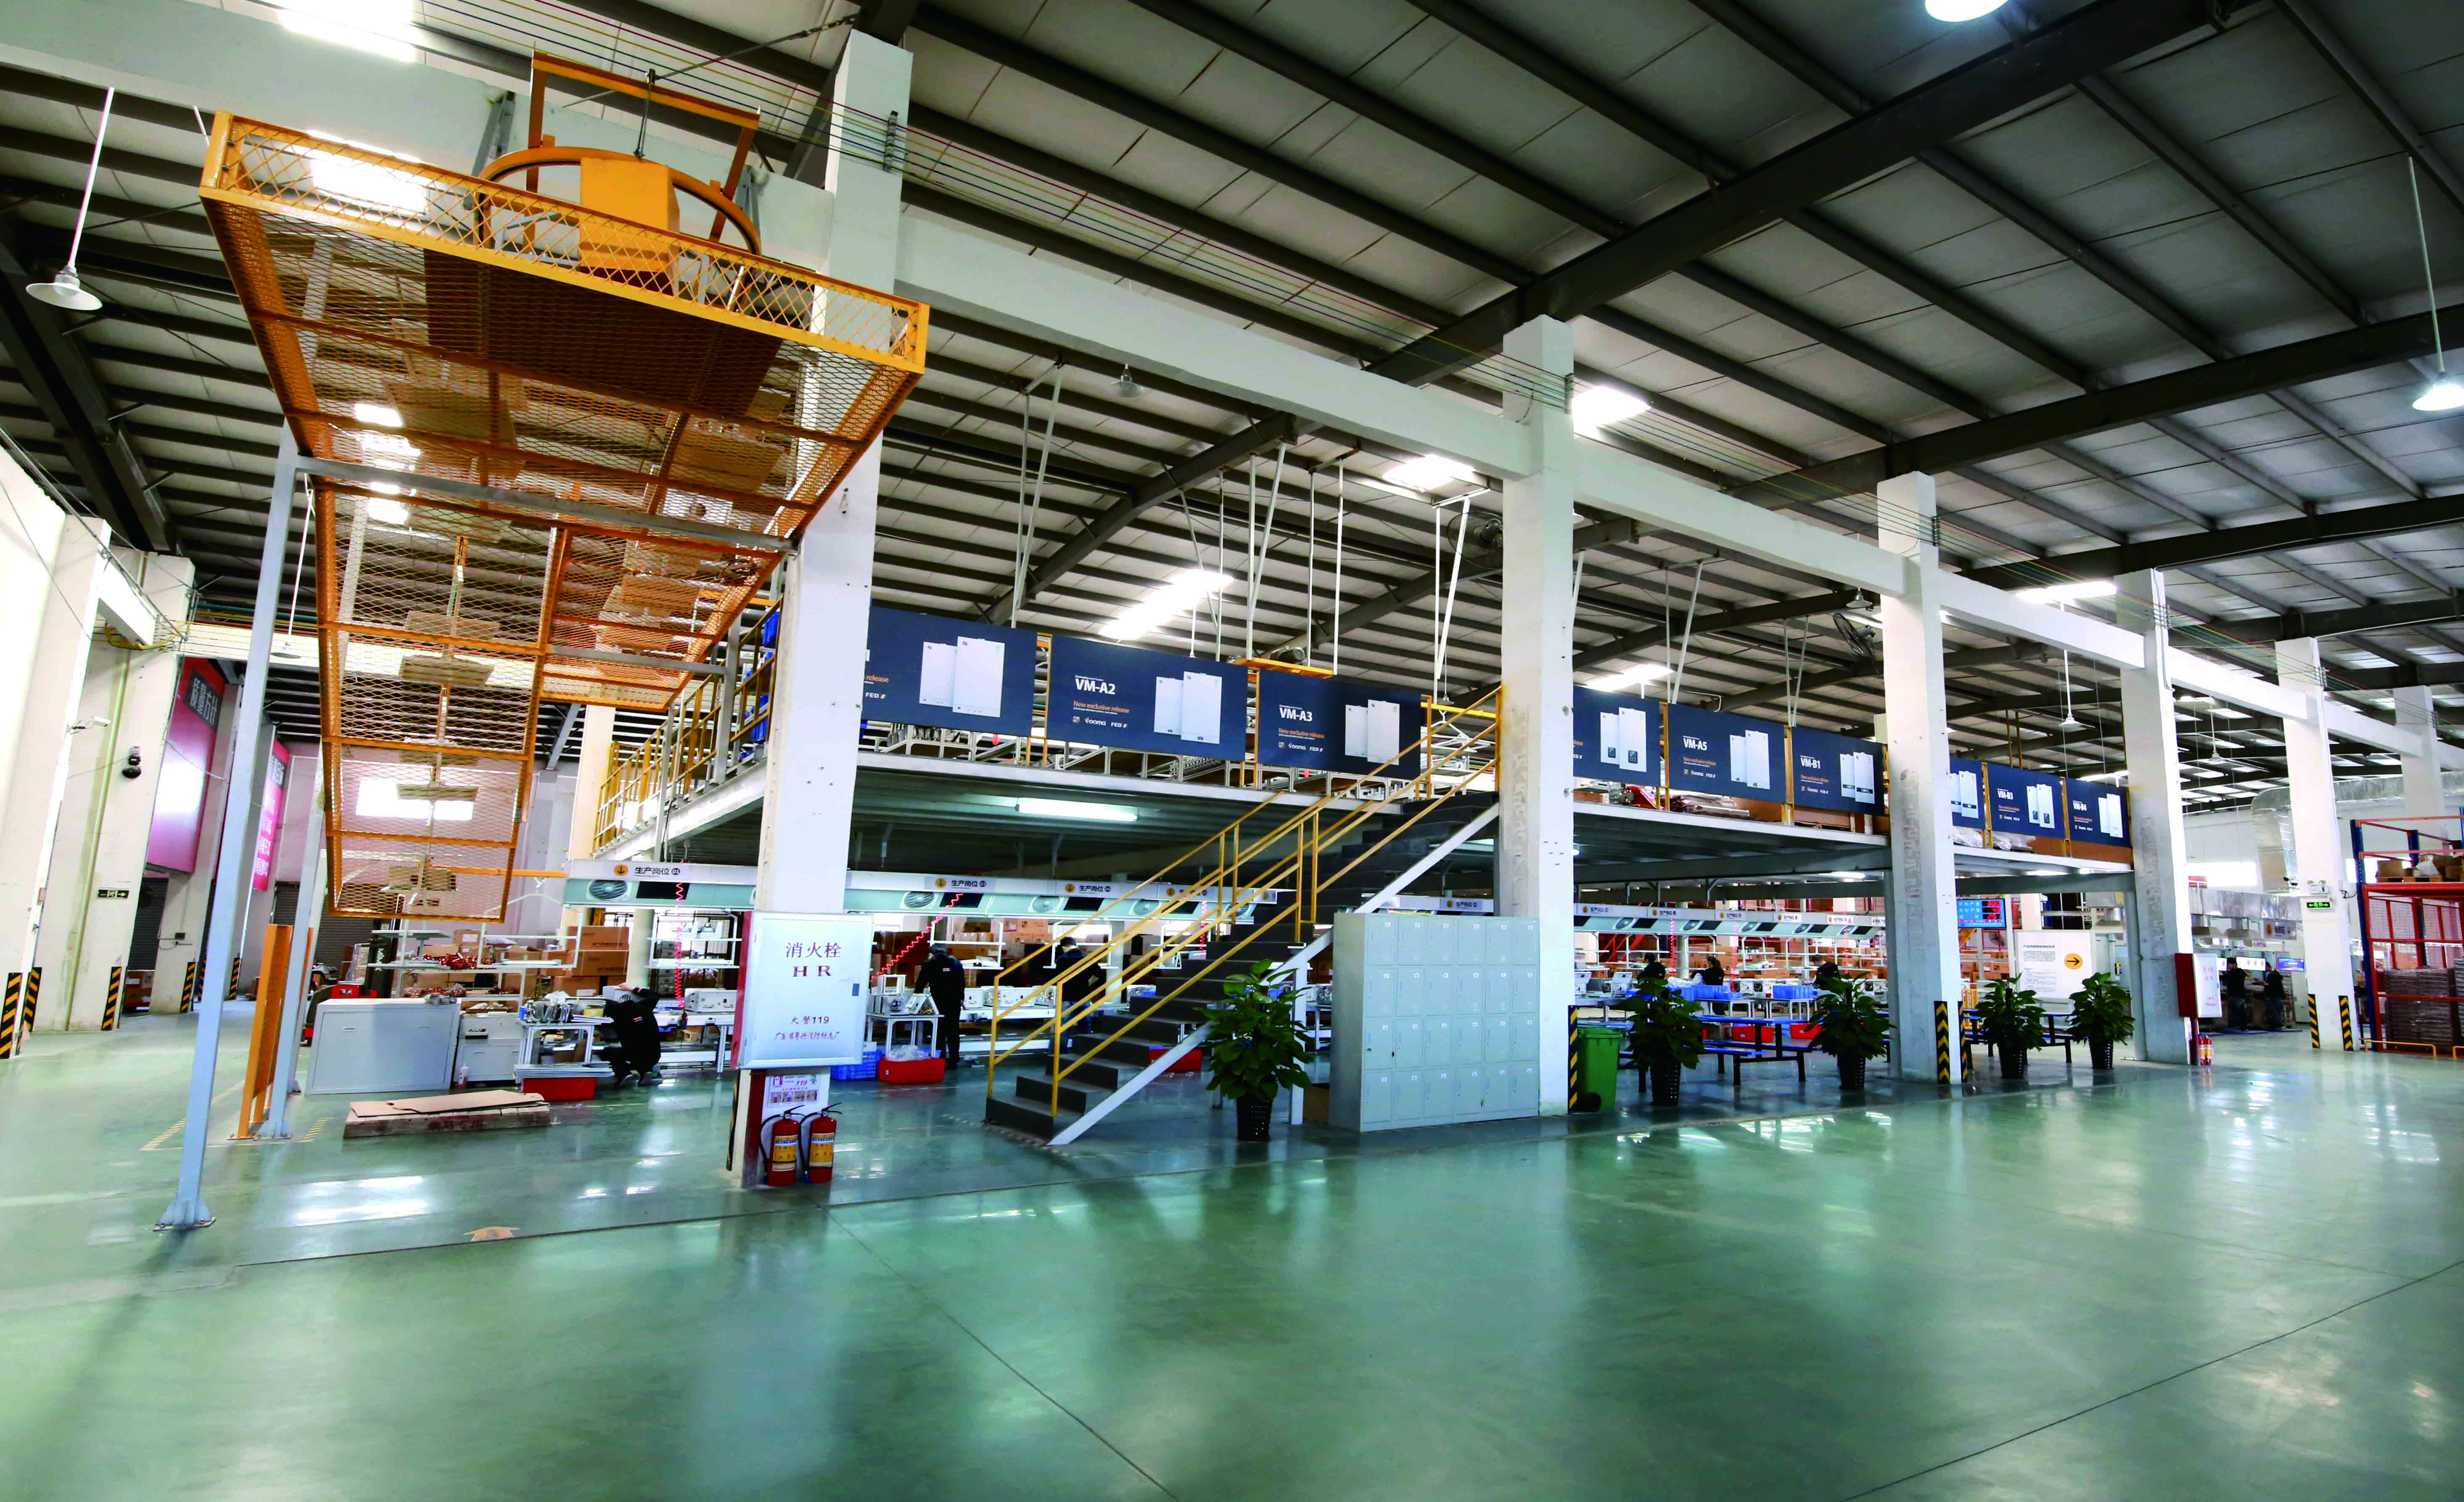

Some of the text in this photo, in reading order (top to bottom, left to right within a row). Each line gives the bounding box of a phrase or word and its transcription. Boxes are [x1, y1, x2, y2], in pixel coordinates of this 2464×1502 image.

[1075, 678, 1116, 695] VM-A2
[1279, 707, 1313, 722] VM-A3
[1683, 737, 1708, 751] VM-A5
[1800, 757, 1821, 769] VM-B1
[634, 866, 670, 875] 生产岗位
[786, 942, 842, 958] 消火栓
